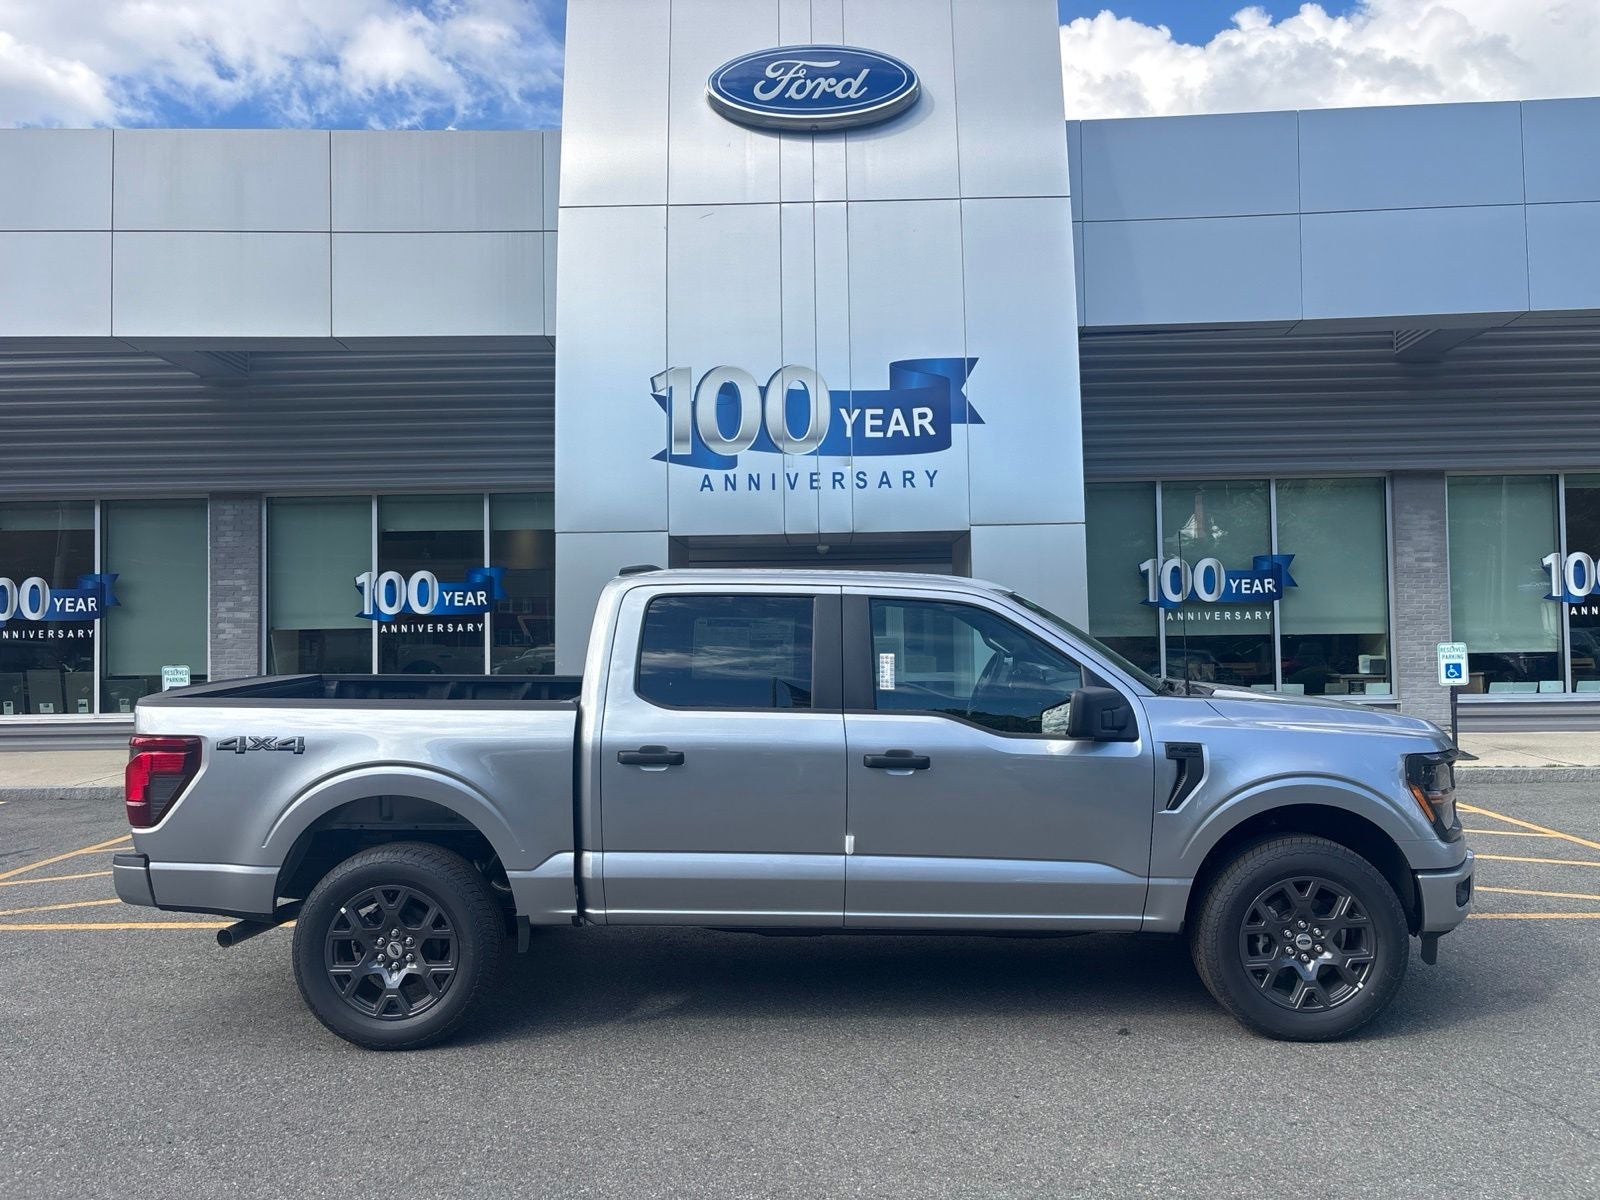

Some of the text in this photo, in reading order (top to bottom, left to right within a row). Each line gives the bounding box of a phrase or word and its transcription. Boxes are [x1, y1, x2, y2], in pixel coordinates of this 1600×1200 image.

[753, 60, 870, 101] Ford
[650, 364, 937, 456] 100 YEAR
[700, 470, 939, 492] ANNIVERSARY
[1139, 558, 1277, 603] 100 YEAR
[355, 570, 488, 615] 100 YEAR
[54, 597, 98, 612] YEAR
[1167, 611, 1272, 622] ANNIVERSARY
[380, 623, 484, 633] ANNIVERSARY
[1440, 645, 1465, 653] RESERVED
